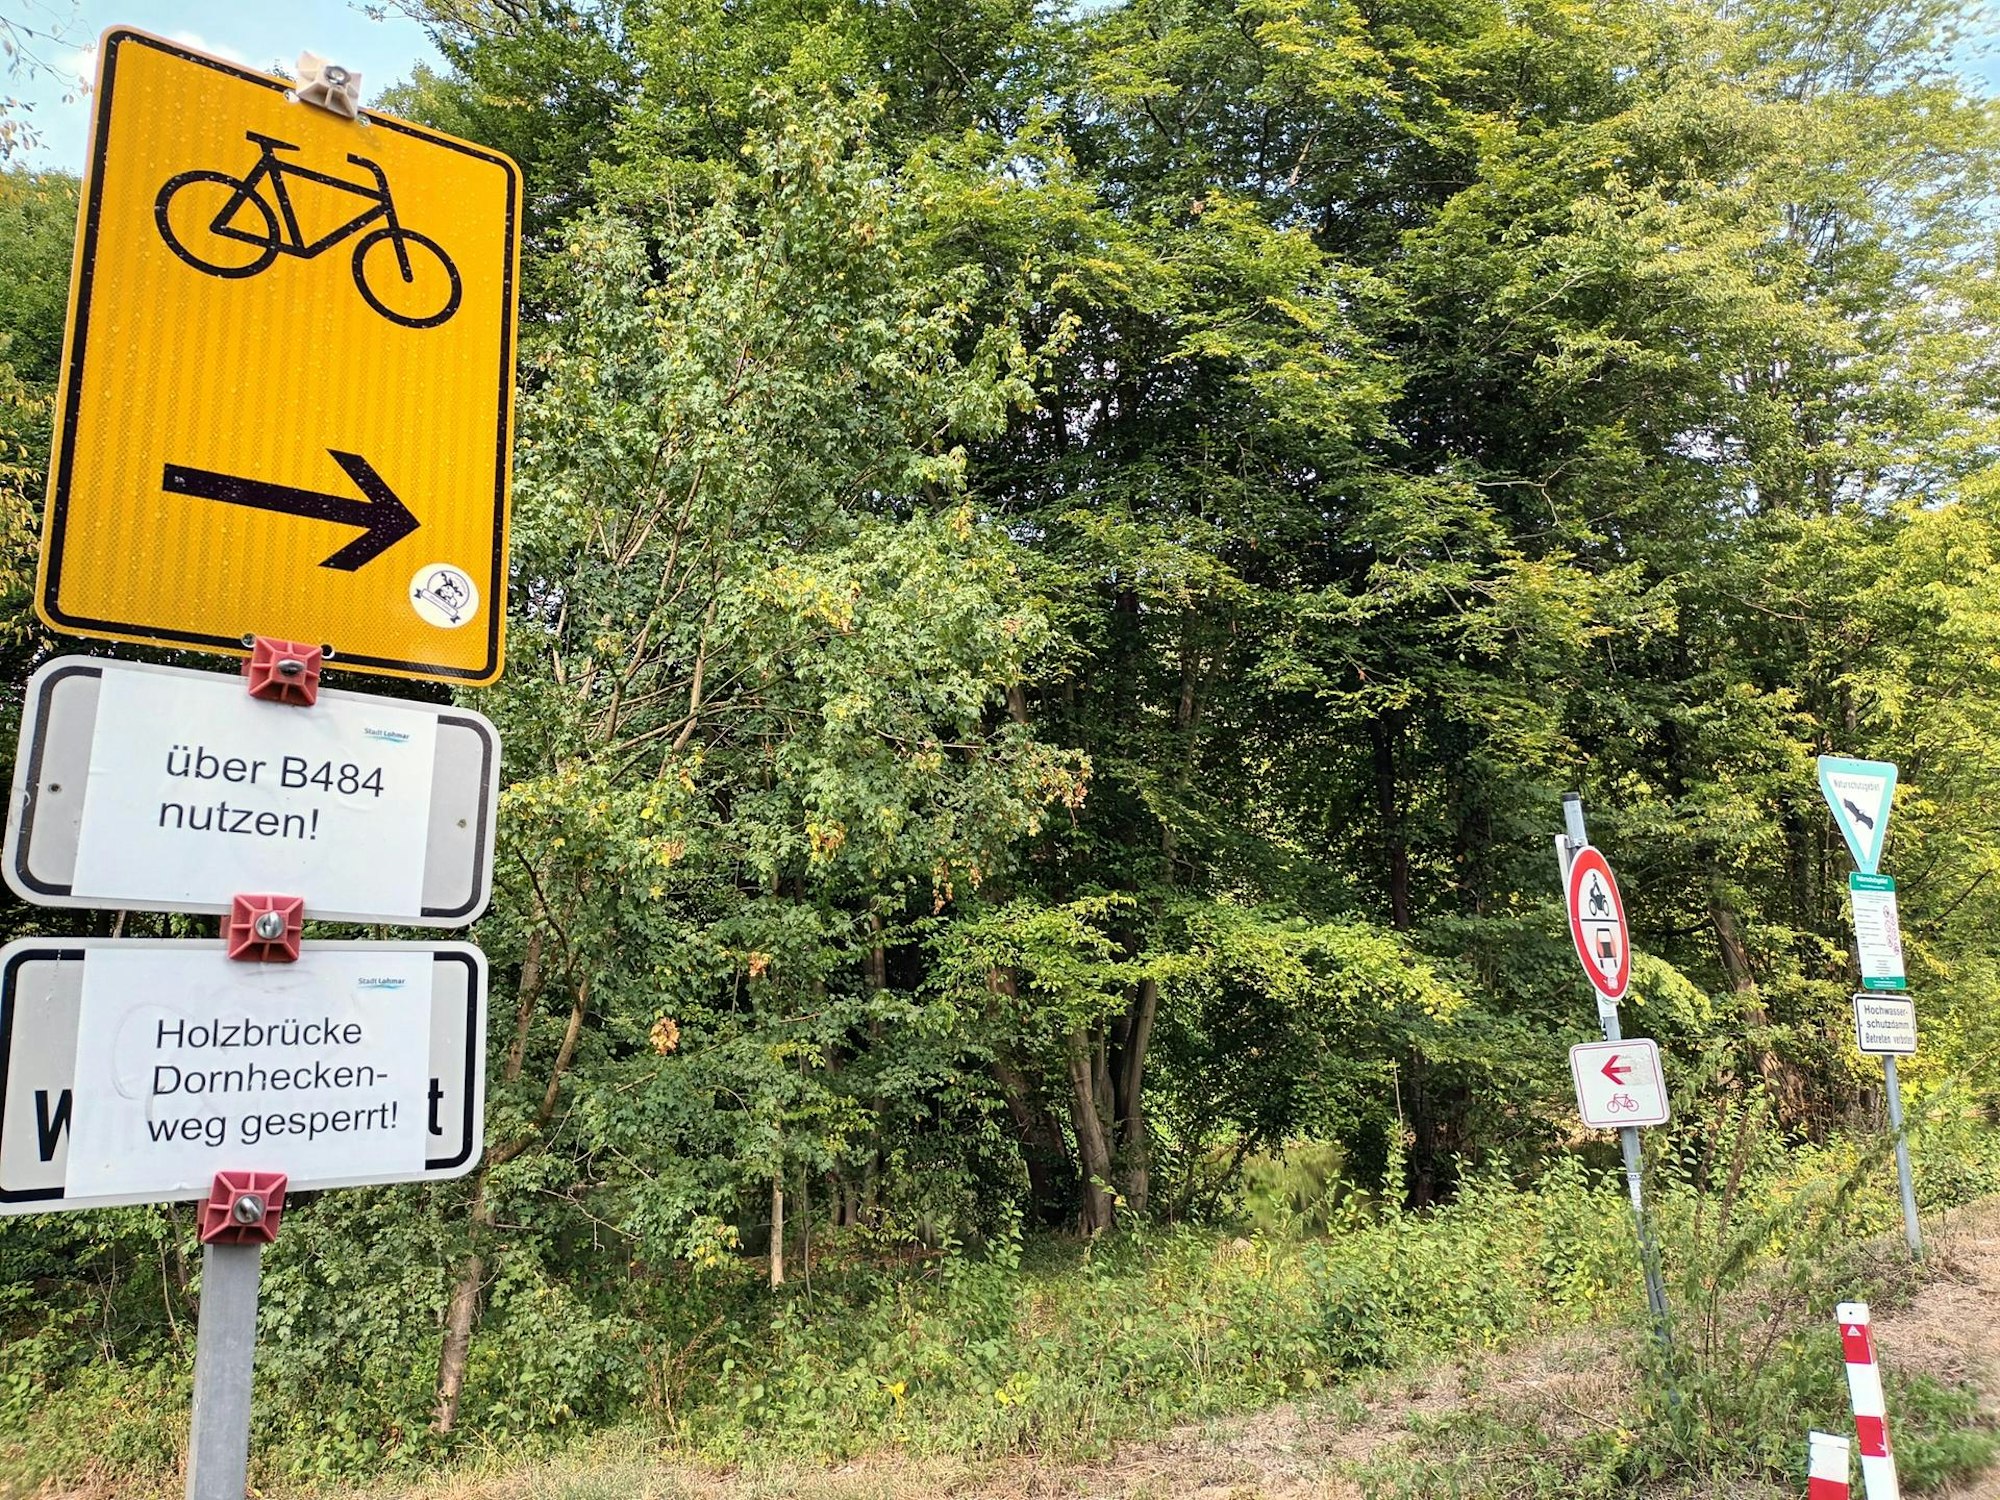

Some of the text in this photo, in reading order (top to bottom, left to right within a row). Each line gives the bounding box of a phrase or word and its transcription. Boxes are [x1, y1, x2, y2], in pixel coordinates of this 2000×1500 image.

[364, 727, 410, 740] Stadt Lohmar
[166, 744, 385, 798] über B484
[158, 800, 320, 841] nutzen!
[358, 976, 406, 985] Stadt Lohmar
[1864, 1004, 1908, 1017] Hochwasser-
[156, 1016, 363, 1049] Holzbrücke
[1866, 1018, 1910, 1030] schutzdamm
[1865, 1032, 1892, 1044] Betreten
[152, 1060, 389, 1096] Dornhecken-
[147, 1115, 227, 1148] weg
[240, 1101, 399, 1146] gesperrt!
